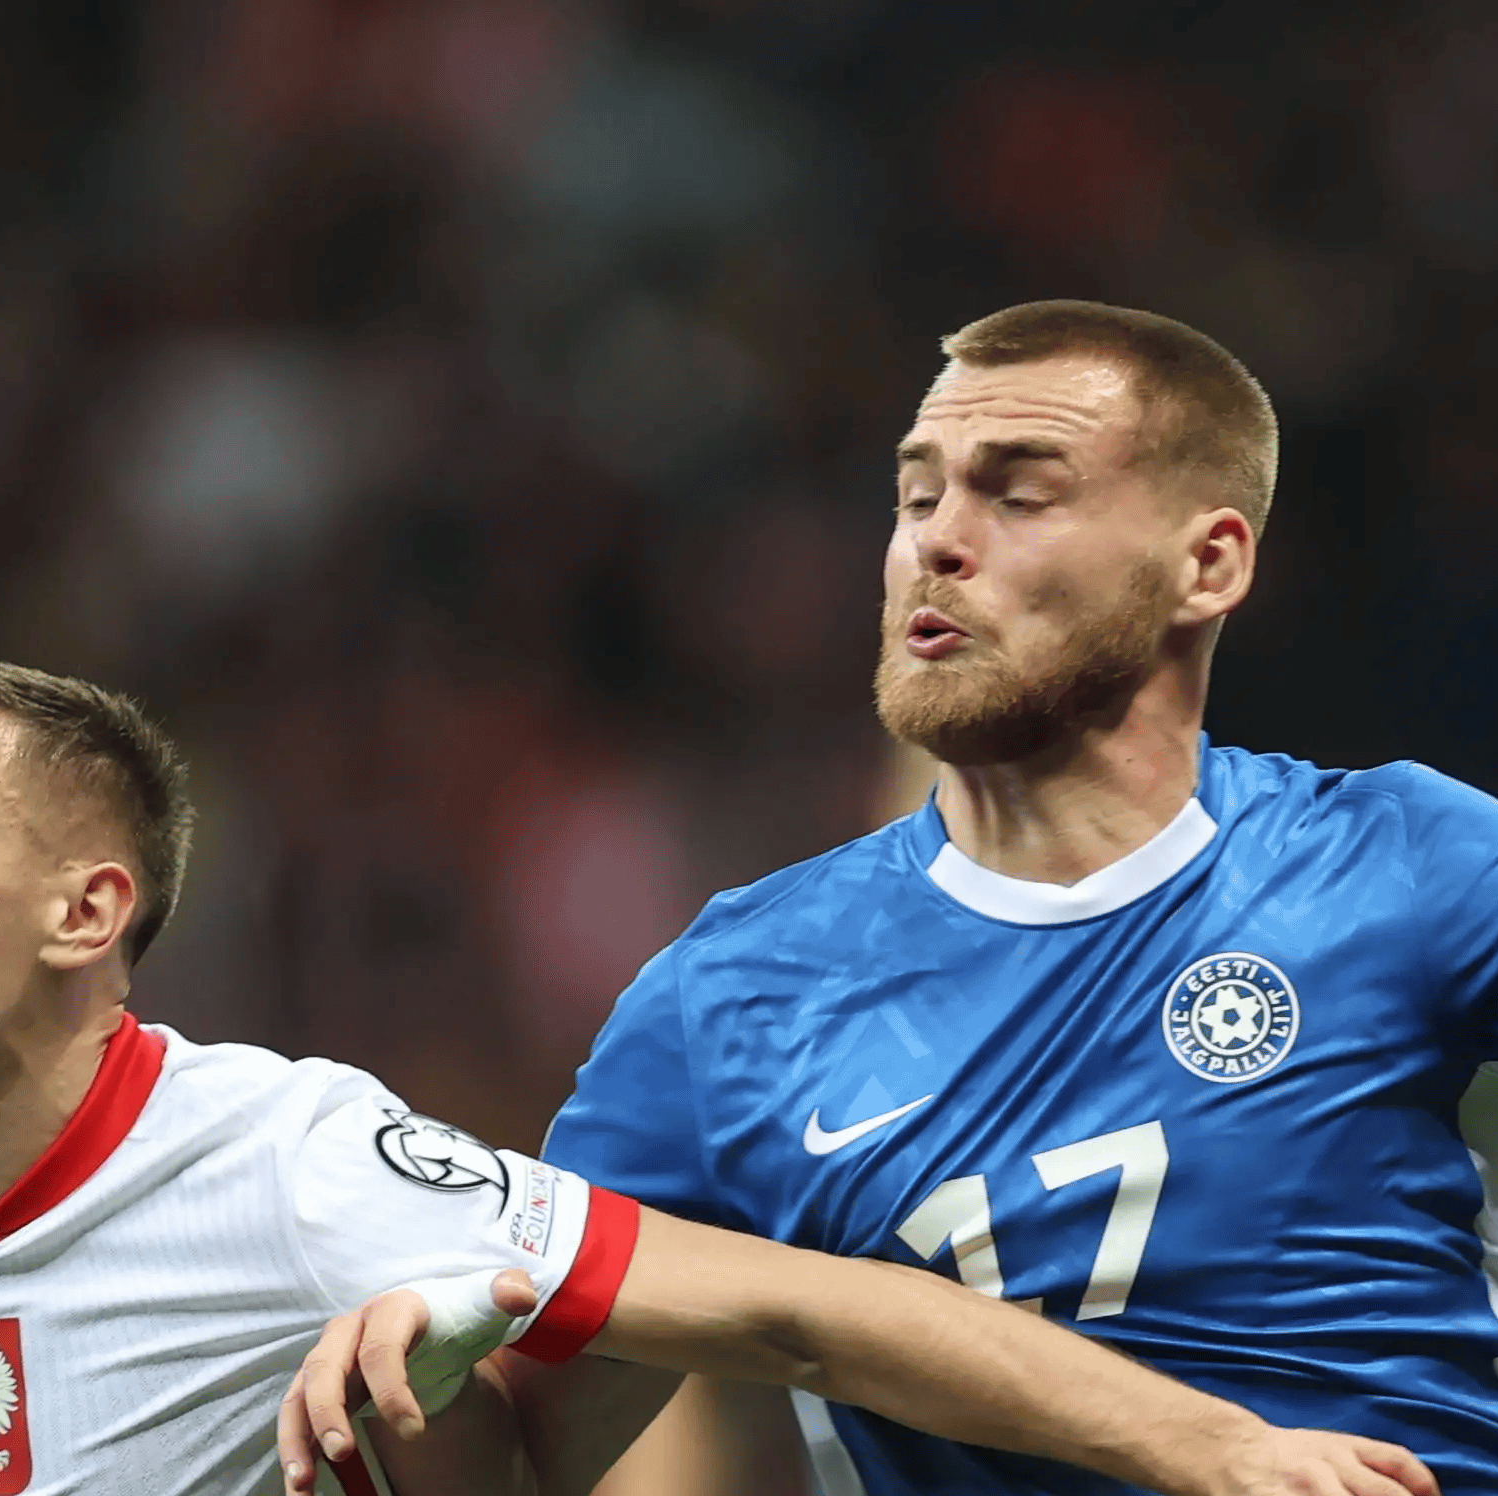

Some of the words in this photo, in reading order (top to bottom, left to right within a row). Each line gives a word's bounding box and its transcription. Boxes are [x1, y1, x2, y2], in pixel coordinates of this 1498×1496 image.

[1186, 959, 1260, 993] EESTI
[1171, 1009, 1278, 1074] JALGPALLI
[1265, 988, 1291, 1038] LIIT
[894, 1119, 1171, 1322] 17
